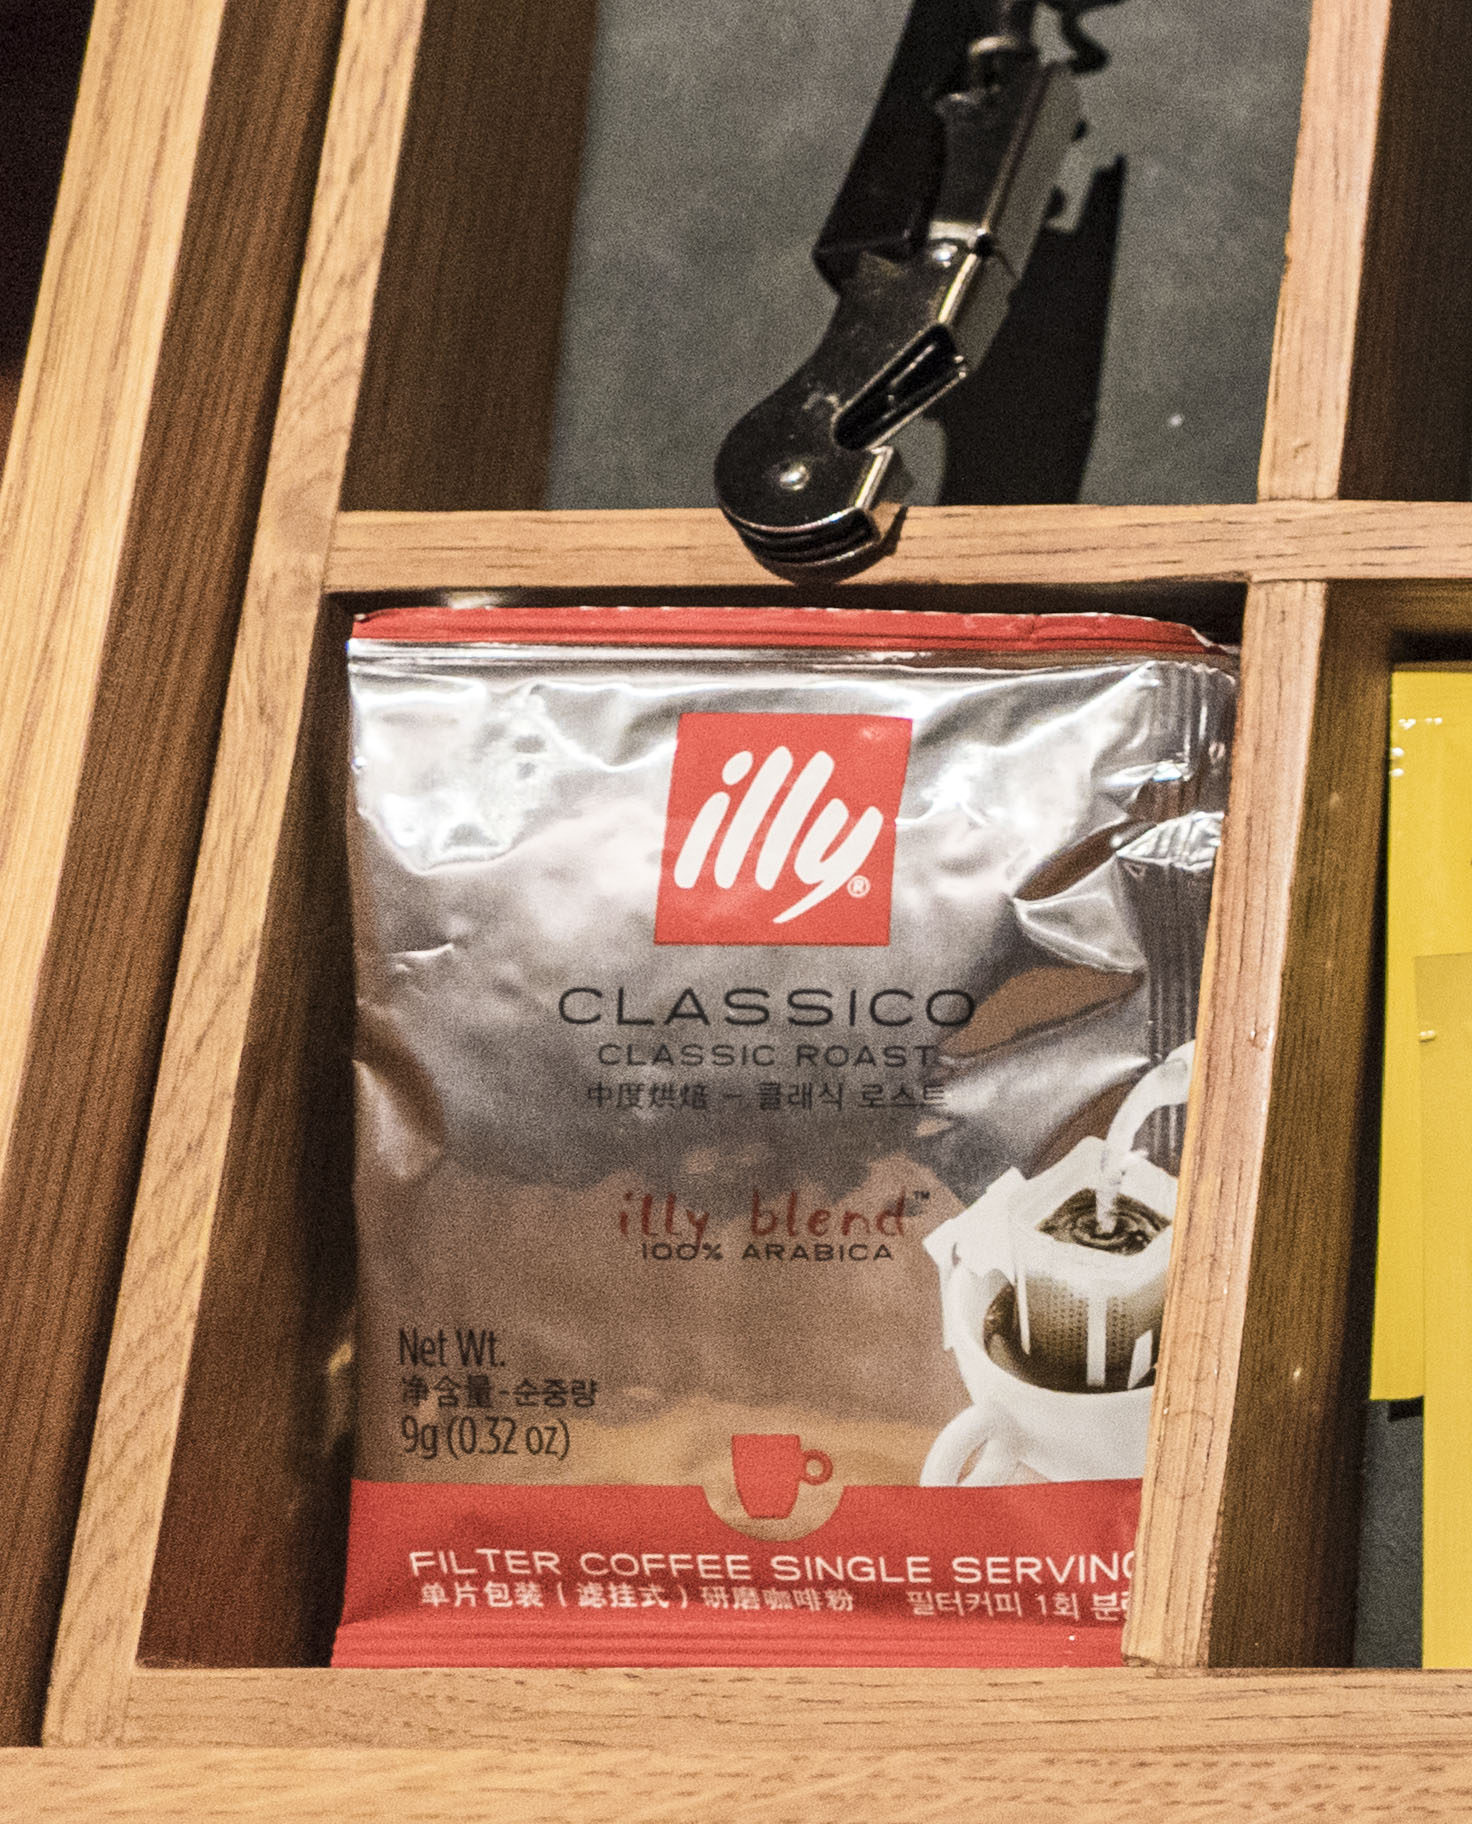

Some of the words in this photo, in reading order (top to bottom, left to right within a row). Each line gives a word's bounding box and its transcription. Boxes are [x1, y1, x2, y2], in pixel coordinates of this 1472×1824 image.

[558, 987, 976, 1027] CLASSICO
[599, 1042, 776, 1067] CLASSIC
[797, 1043, 939, 1068] ROAST
[758, 1082, 843, 1111] 클래식
[859, 1083, 947, 1110] 로스트
[618, 1191, 710, 1242] illy
[642, 1242, 724, 1262] 100%
[742, 1242, 893, 1263] ARABICA
[400, 1327, 447, 1367] Net
[456, 1328, 506, 1367] Wt.
[401, 1415, 438, 1459] 9g
[448, 1416, 517, 1460] (0.32
[525, 1418, 570, 1461] oz)
[409, 1549, 561, 1577] FILTER
[580, 1552, 752, 1580] COFFEE
[770, 1555, 931, 1584] SINGLE
[907, 1590, 1023, 1618] 필터커피
